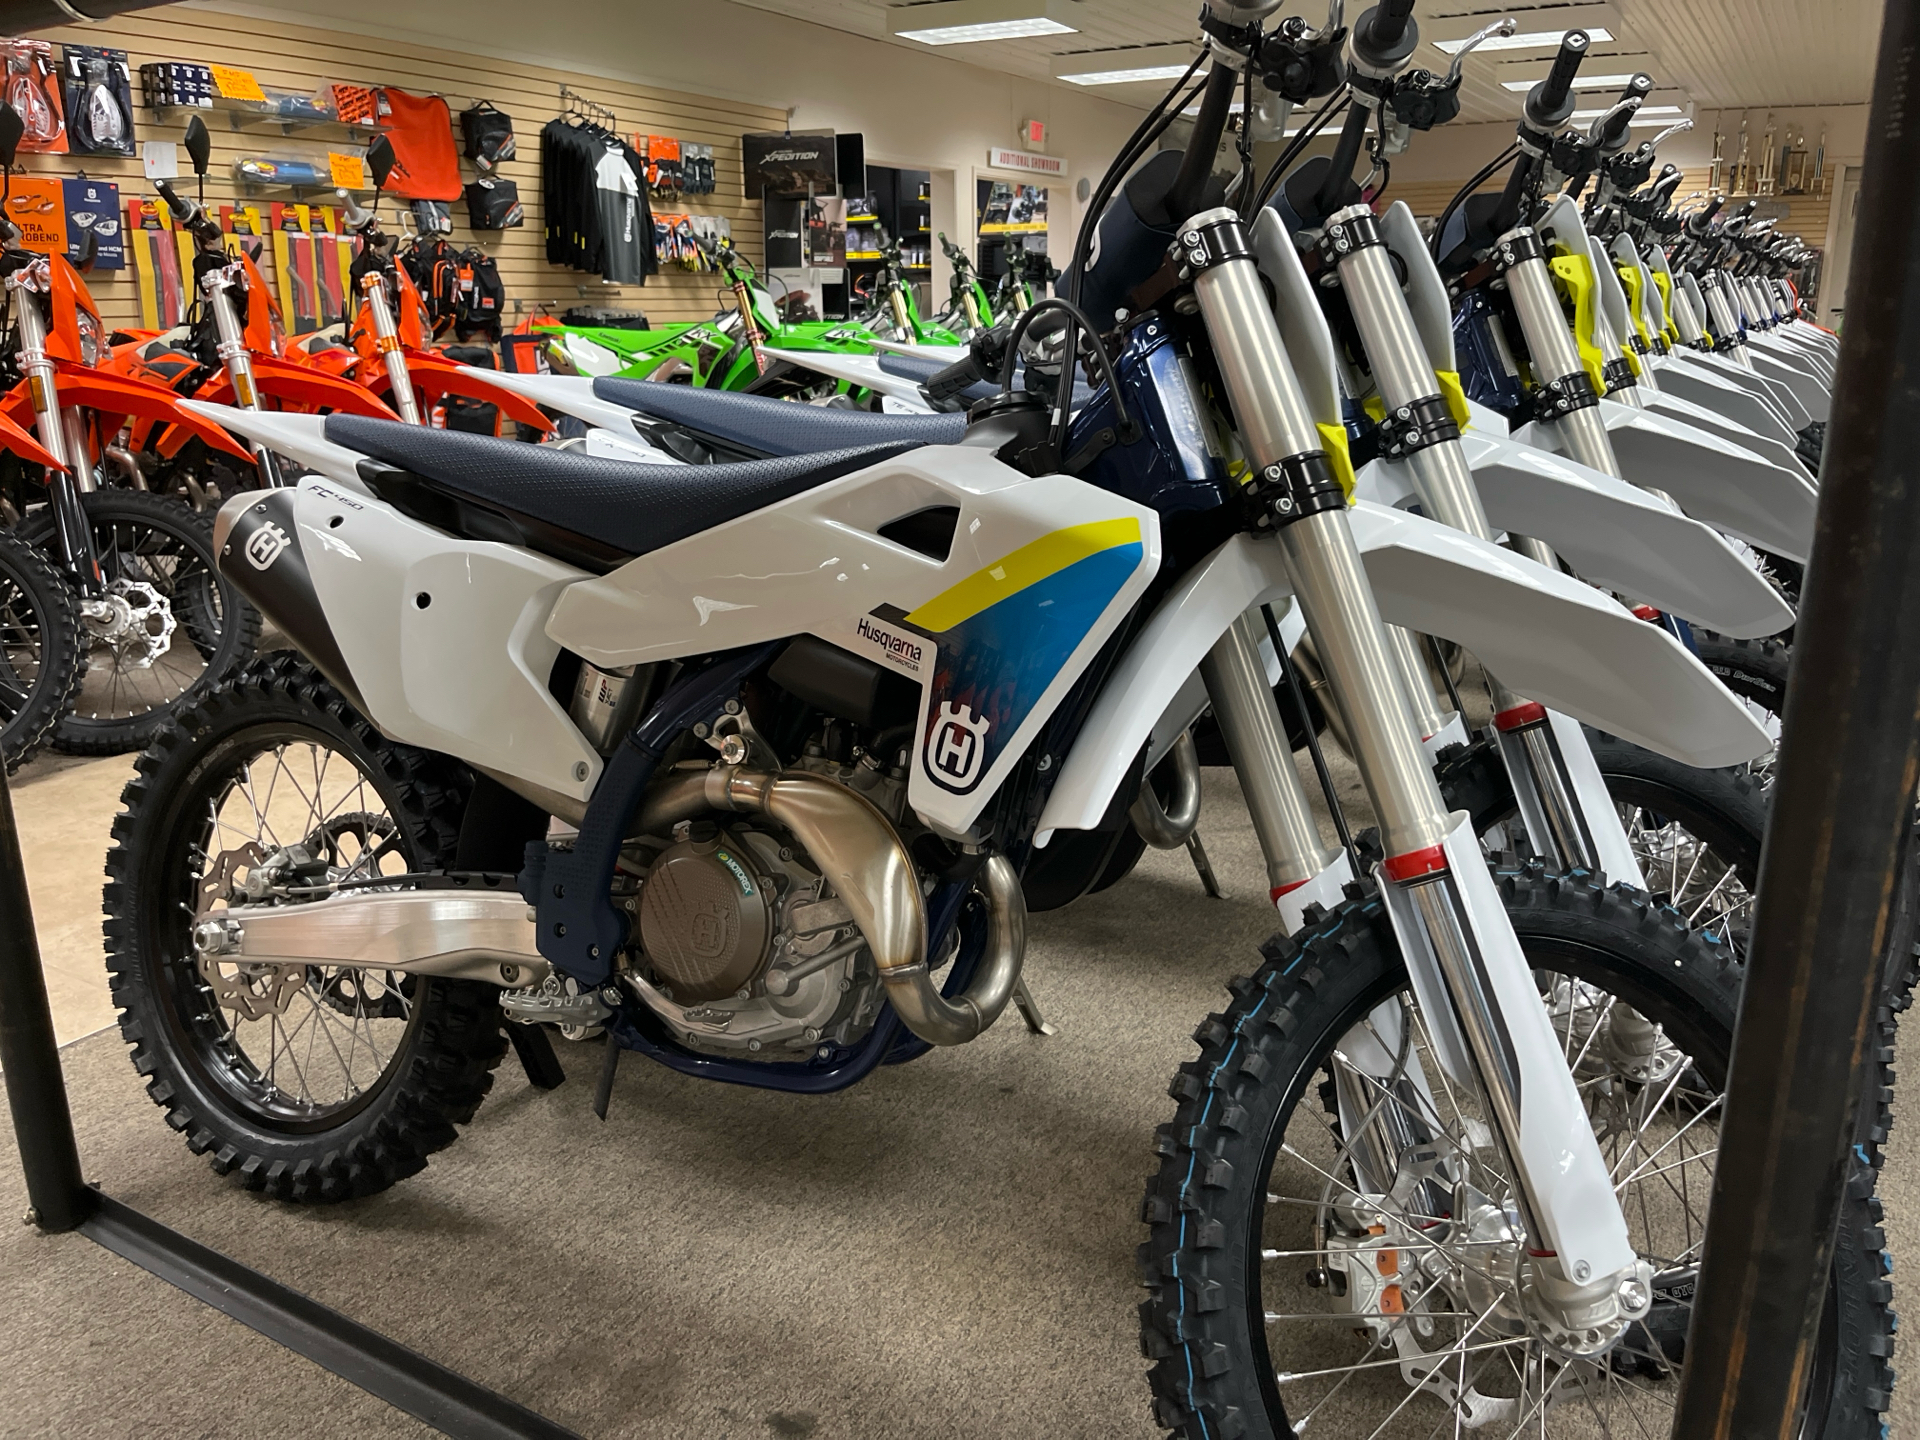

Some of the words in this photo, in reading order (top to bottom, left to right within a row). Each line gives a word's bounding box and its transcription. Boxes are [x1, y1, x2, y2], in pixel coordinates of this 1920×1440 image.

[759, 150, 819, 165] XPEDITION
[999, 151, 1030, 168] ADDITIONAL
[1031, 157, 1060, 172] SHOWROOM
[691, 328, 718, 340] KX
[308, 485, 334, 498] FC
[334, 494, 364, 510] 450
[857, 617, 922, 662] Husqvarna
[886, 653, 919, 672] MOTORCYCLES
[726, 858, 752, 894] MOTOREX
